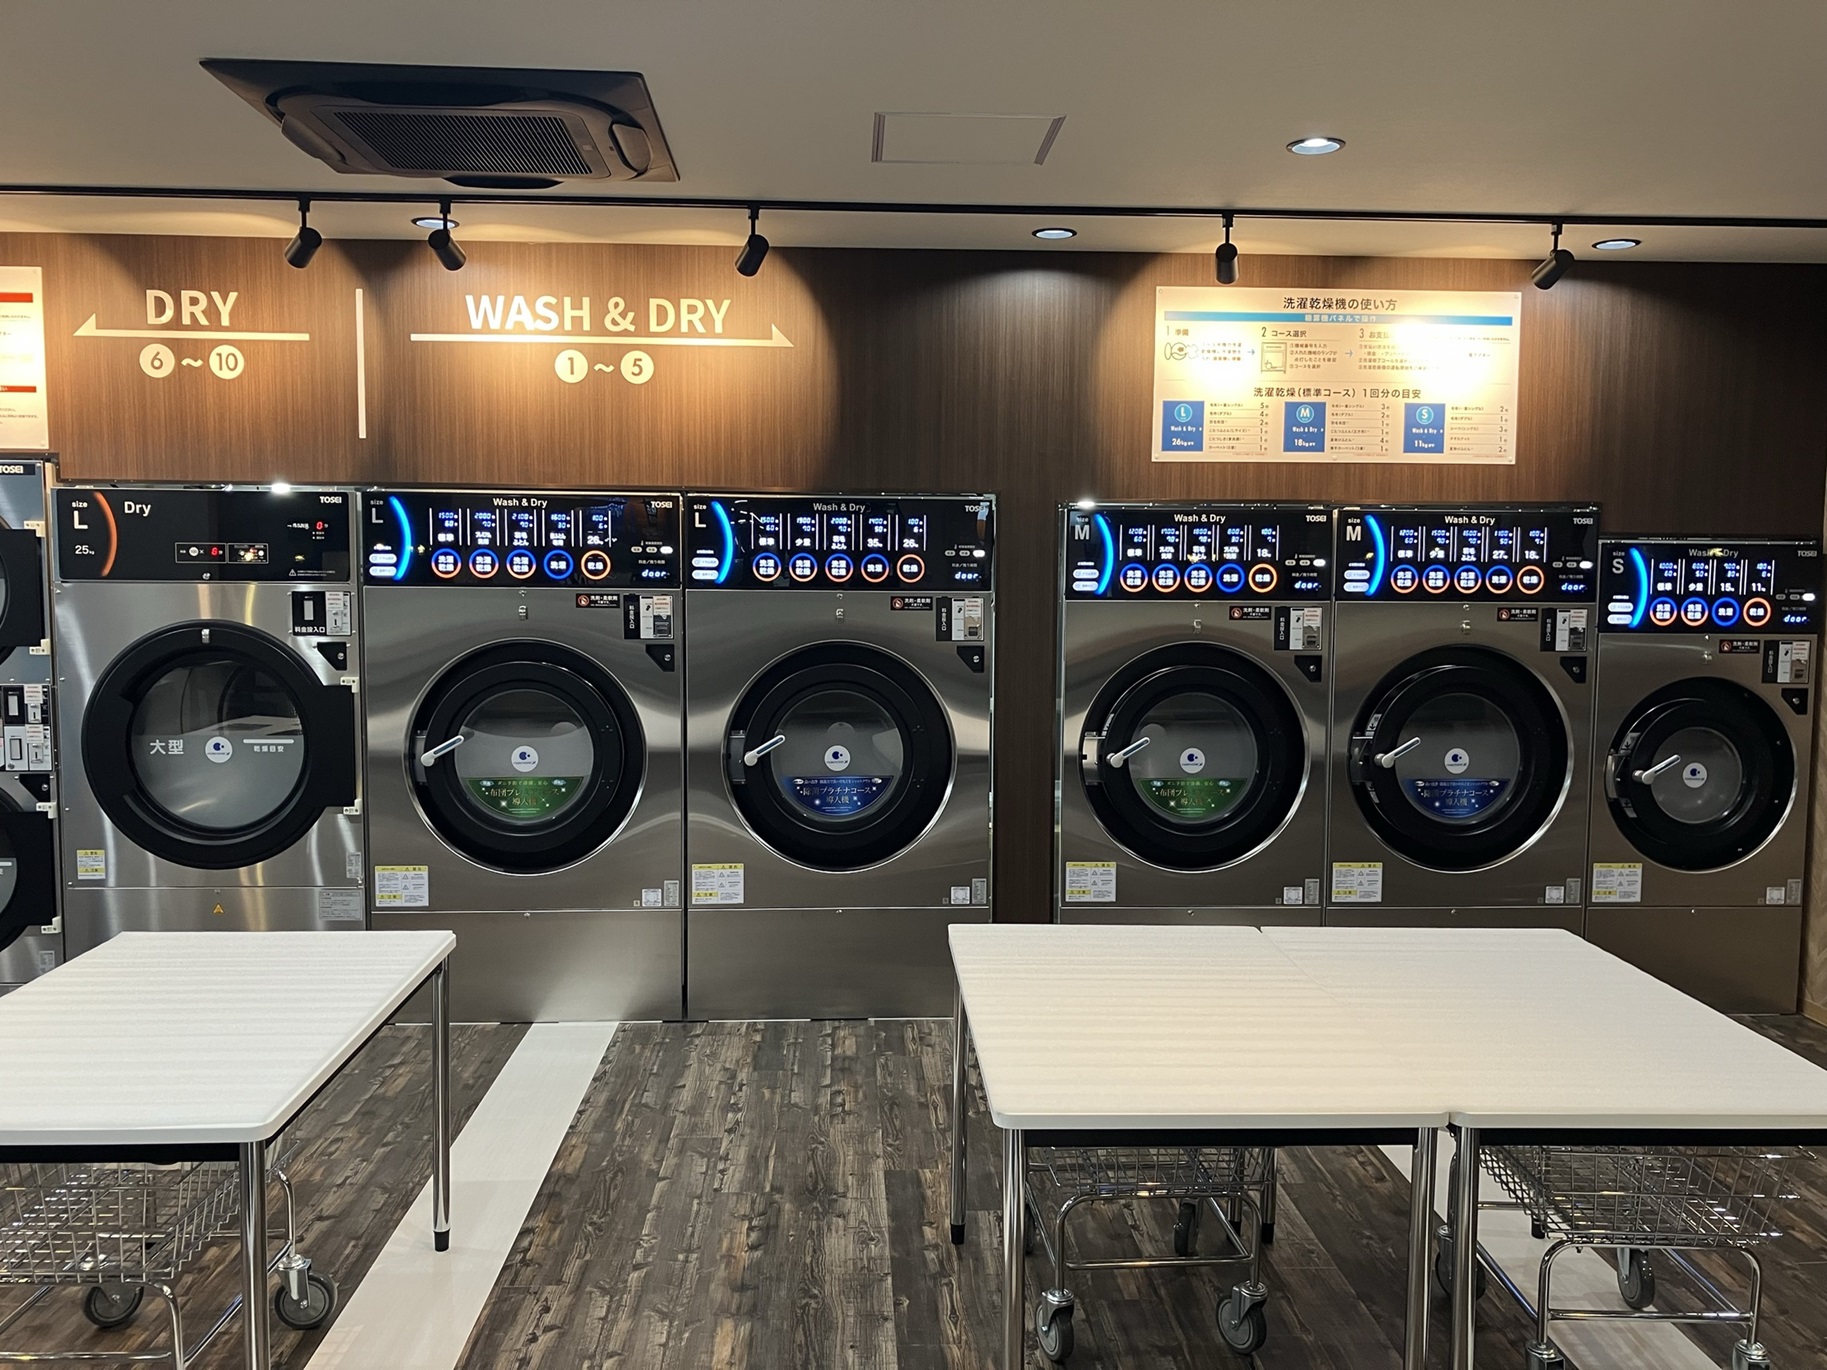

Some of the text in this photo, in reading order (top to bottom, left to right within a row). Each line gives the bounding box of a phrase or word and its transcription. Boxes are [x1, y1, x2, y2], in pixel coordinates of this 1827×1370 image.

[146, 289, 238, 326] DRY
[1283, 296, 1398, 311] 洗濯乾燥機の使い方
[465, 295, 731, 334] WASH & DRY
[1261, 326, 1307, 338] 2 コース選択
[1359, 328, 1365, 339] 3
[1254, 387, 1422, 399] 洗濯乾燥(標準コース) 1回分の目安
[1180, 406, 1186, 416] L
[1300, 408, 1310, 418] M
[1422, 409, 1428, 419] S
[493, 498, 519, 506] Wash
[530, 499, 548, 508] Dry
[813, 503, 838, 511] Wash
[849, 504, 866, 512] Dry
[124, 501, 151, 516] Dry
[74, 510, 88, 530] L
[372, 508, 384, 523] L
[694, 512, 706, 527] L
[1174, 514, 1198, 522] Wash
[1210, 514, 1226, 524] Dry
[1480, 516, 1495, 526] Dry
[1074, 525, 1090, 540] M
[1346, 526, 1362, 541] M
[587, 536, 604, 545] 26
[867, 538, 883, 547] 35
[903, 539, 918, 548] 26
[1257, 549, 1271, 557] 18
[1493, 551, 1508, 559] 27
[1525, 551, 1540, 559] 18
[1723, 549, 1738, 558] Dry
[1612, 558, 1624, 574] S
[642, 569, 666, 577] door
[1294, 581, 1318, 589] door
[1561, 582, 1585, 591] door
[1720, 583, 1735, 591] 15
[1751, 583, 1766, 591] 11
[1783, 614, 1807, 623] door
[150, 739, 184, 755] 大型
[254, 745, 284, 753] 乾燥目安
